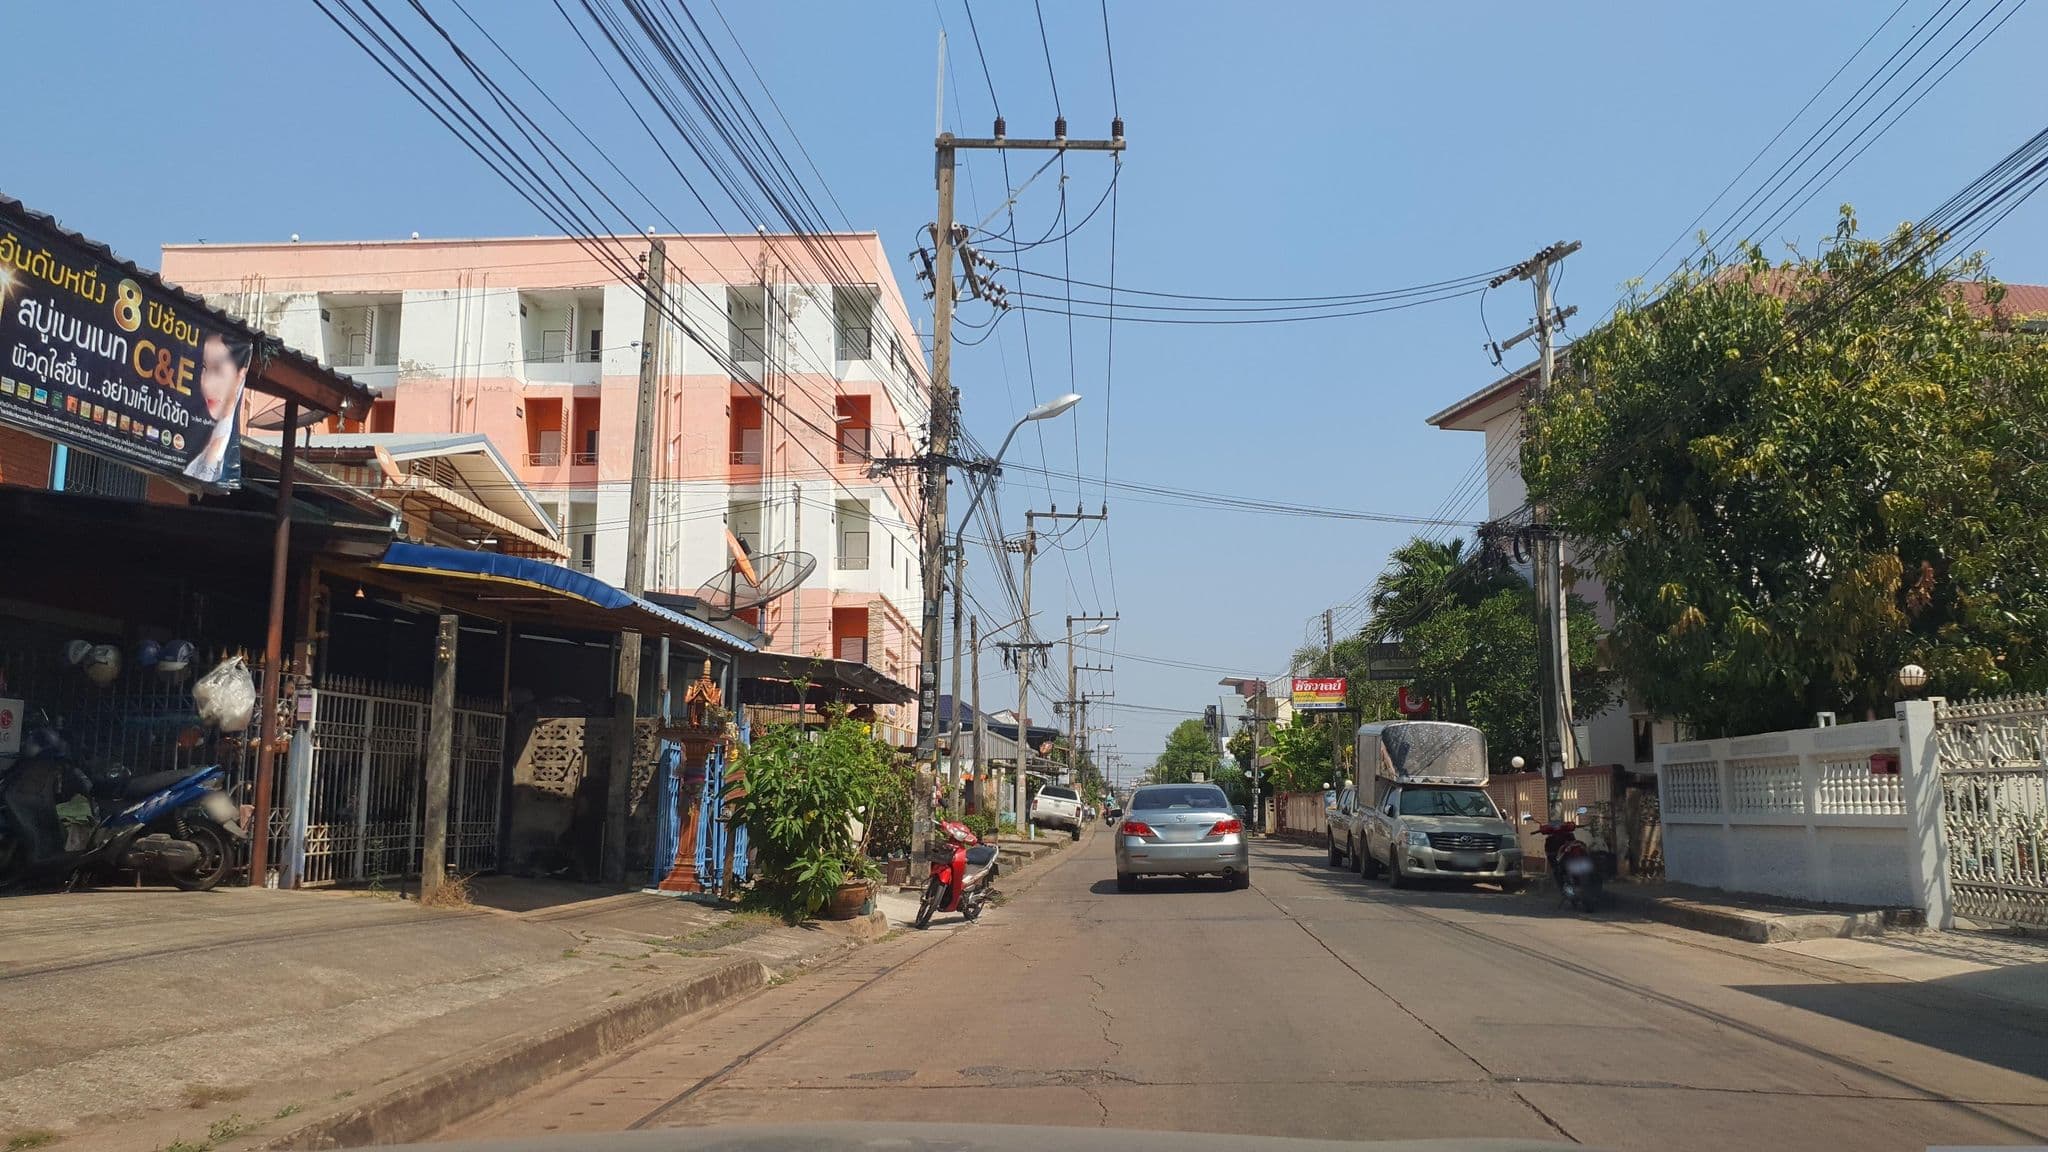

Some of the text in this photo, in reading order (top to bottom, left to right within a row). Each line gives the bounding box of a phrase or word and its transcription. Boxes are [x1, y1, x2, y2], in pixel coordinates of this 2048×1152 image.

[17, 298, 196, 397] สบู่เบนเนท C&E
[113, 278, 143, 333] 8
[147, 300, 200, 348] ปีซ้อน
